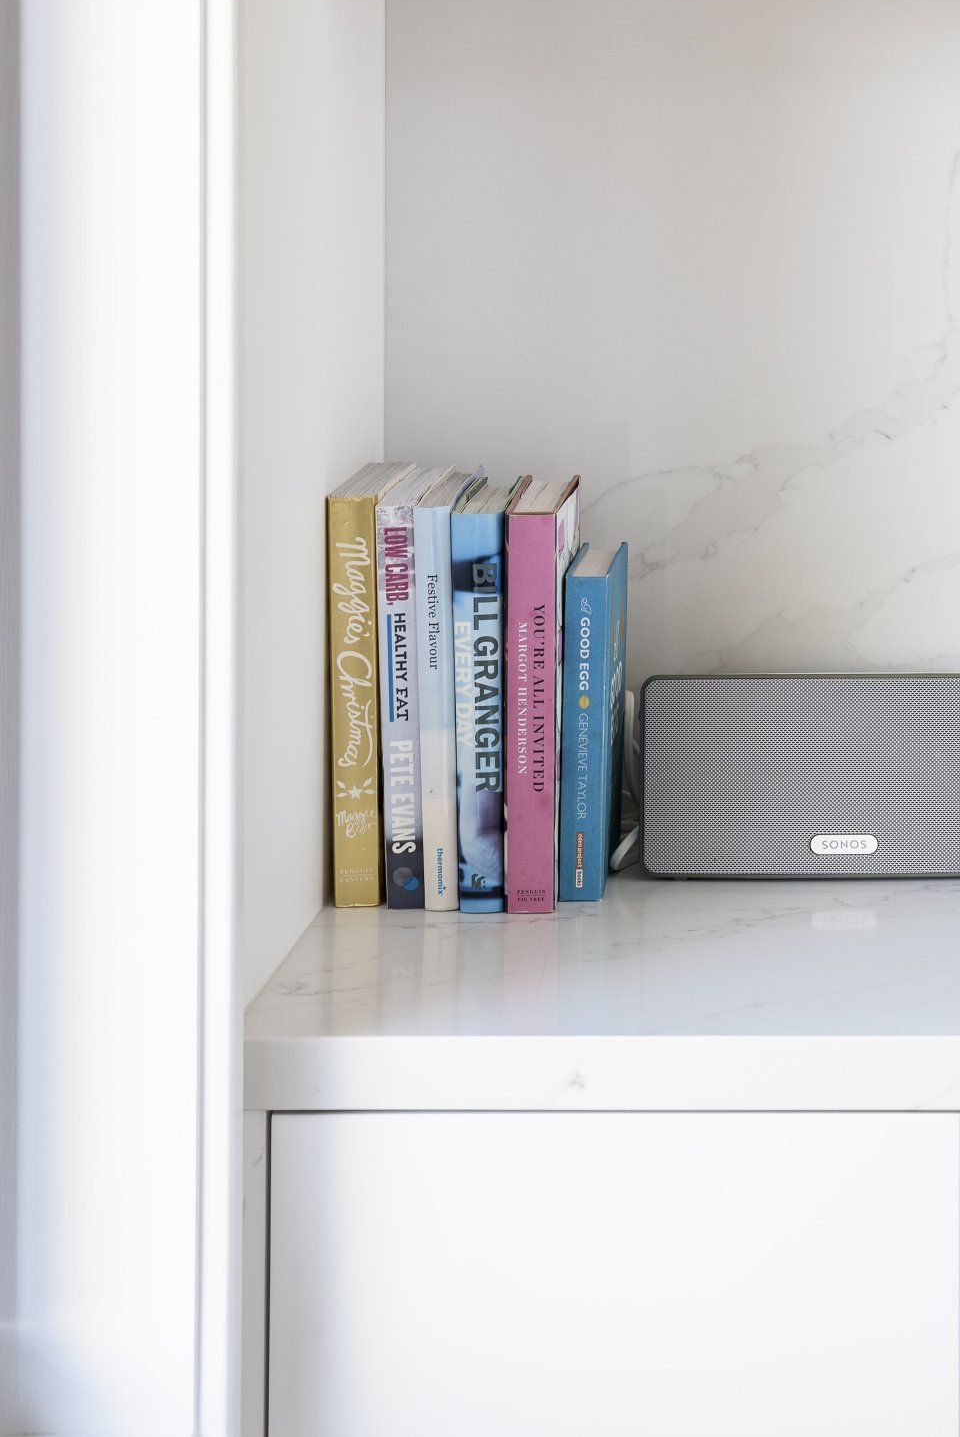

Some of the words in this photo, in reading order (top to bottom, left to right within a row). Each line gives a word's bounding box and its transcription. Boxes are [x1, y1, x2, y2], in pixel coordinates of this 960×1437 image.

[383, 526, 408, 559] LOW
[332, 536, 372, 644] Maggie's
[384, 562, 409, 606] CARB,
[427, 574, 439, 619] Festive
[472, 562, 498, 631] BILL
[394, 612, 408, 682] HEALTHY
[428, 622, 440, 670] Flavour
[454, 621, 473, 699] EVERY
[518, 622, 528, 682] MARGOT
[533, 603, 546, 669] YOU'RE
[580, 617, 591, 659] GOOD
[533, 675, 545, 709] ALL
[579, 662, 590, 691] EGG
[336, 650, 373, 767] Christmas
[395, 687, 409, 722] FAT
[456, 703, 473, 748] DAY
[473, 635, 500, 793] GRANGER
[517, 687, 527, 774] HENDERSON
[532, 715, 545, 792] INVITED
[577, 713, 589, 772] GENEVIEVE
[389, 739, 415, 787] PETE
[576, 776, 588, 820] TAYLOR
[390, 792, 417, 854] EVANS
[821, 839, 867, 850] SONOS
[339, 867, 374, 875] PENGUIN
[436, 848, 446, 896] thermomix
